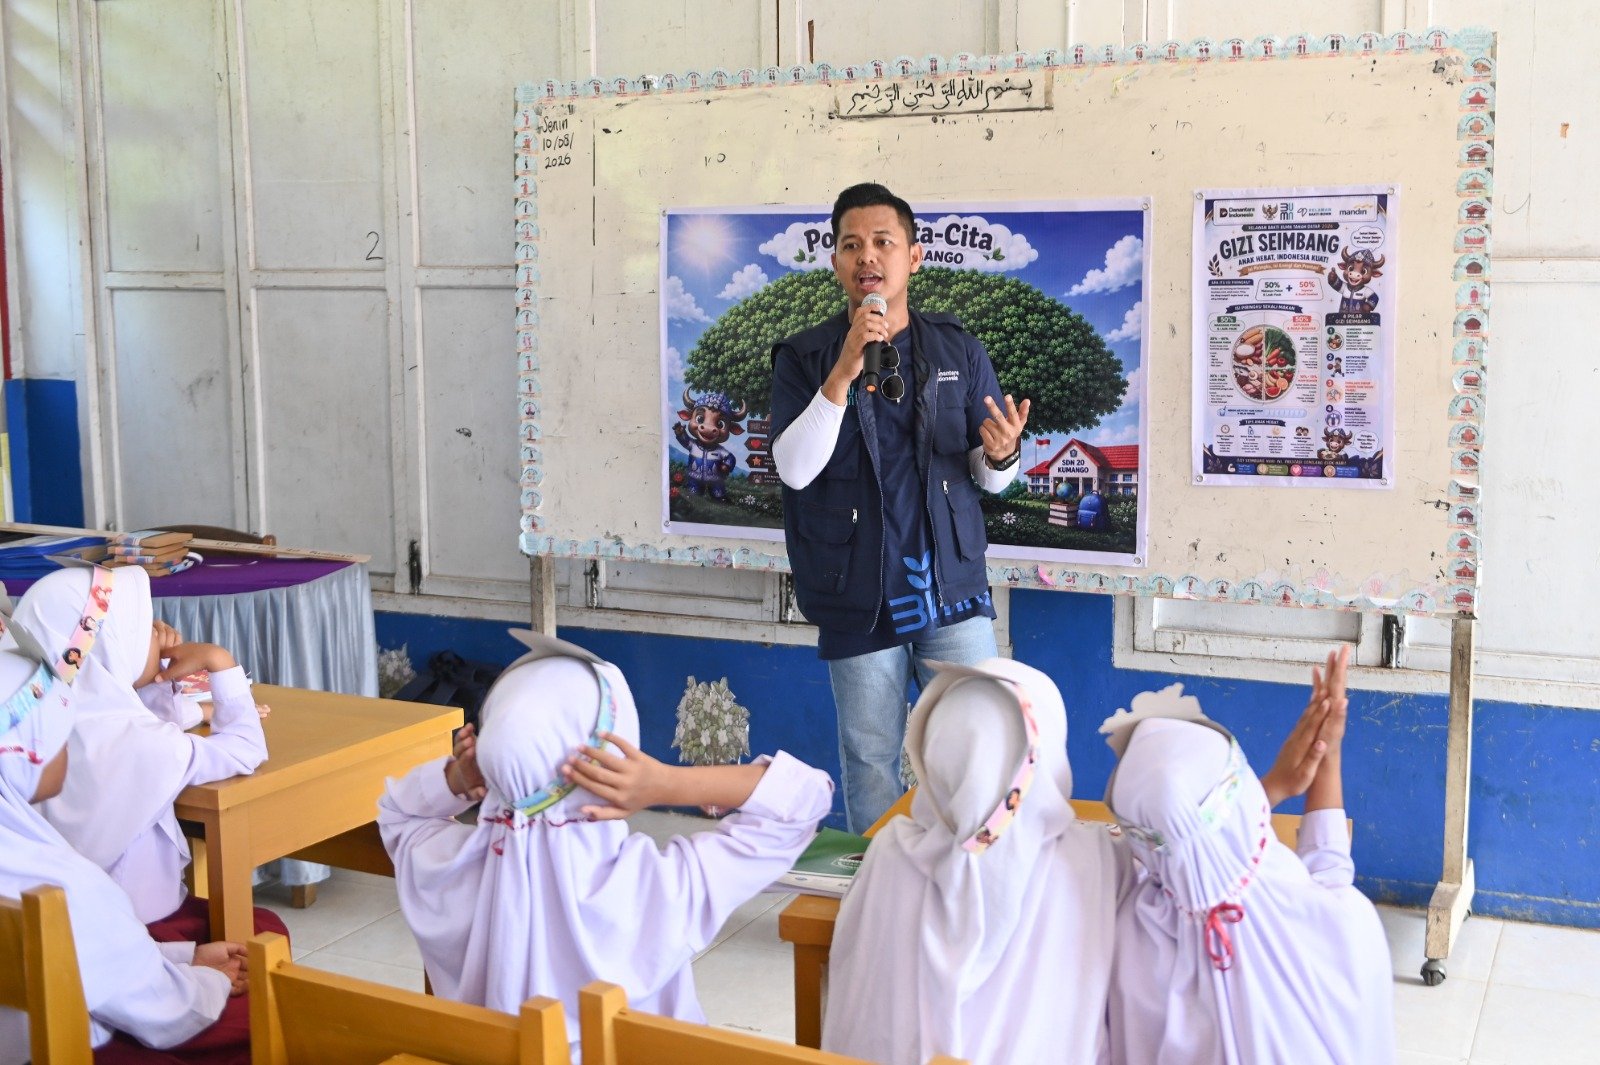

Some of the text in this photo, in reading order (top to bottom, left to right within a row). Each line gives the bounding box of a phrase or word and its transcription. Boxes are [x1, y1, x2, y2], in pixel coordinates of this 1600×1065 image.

[542, 116, 568, 133] Senin
[545, 153, 571, 169] 2026
[365, 231, 383, 260] 2
[914, 222, 993, 251] ta-Cita
[1220, 232, 1339, 260] GIZI SEIMBANG
[1238, 256, 1255, 265] ANAK
[1311, 255, 1329, 263] KUAT!
